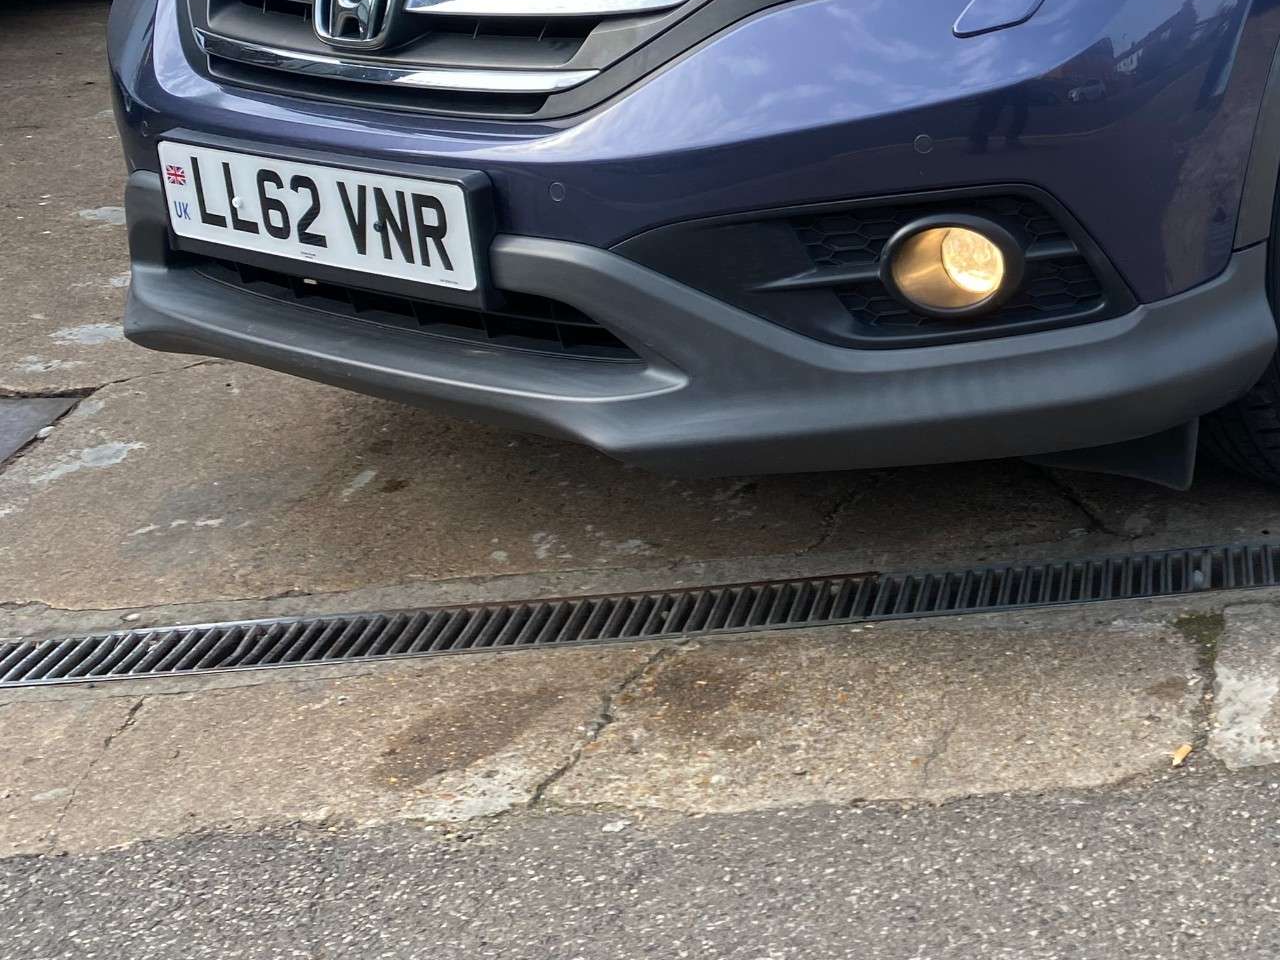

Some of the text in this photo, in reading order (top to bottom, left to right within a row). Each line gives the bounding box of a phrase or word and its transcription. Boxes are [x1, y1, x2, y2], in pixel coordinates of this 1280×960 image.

[174, 200, 192, 221] UK
[190, 156, 455, 272] LL62 VNR
